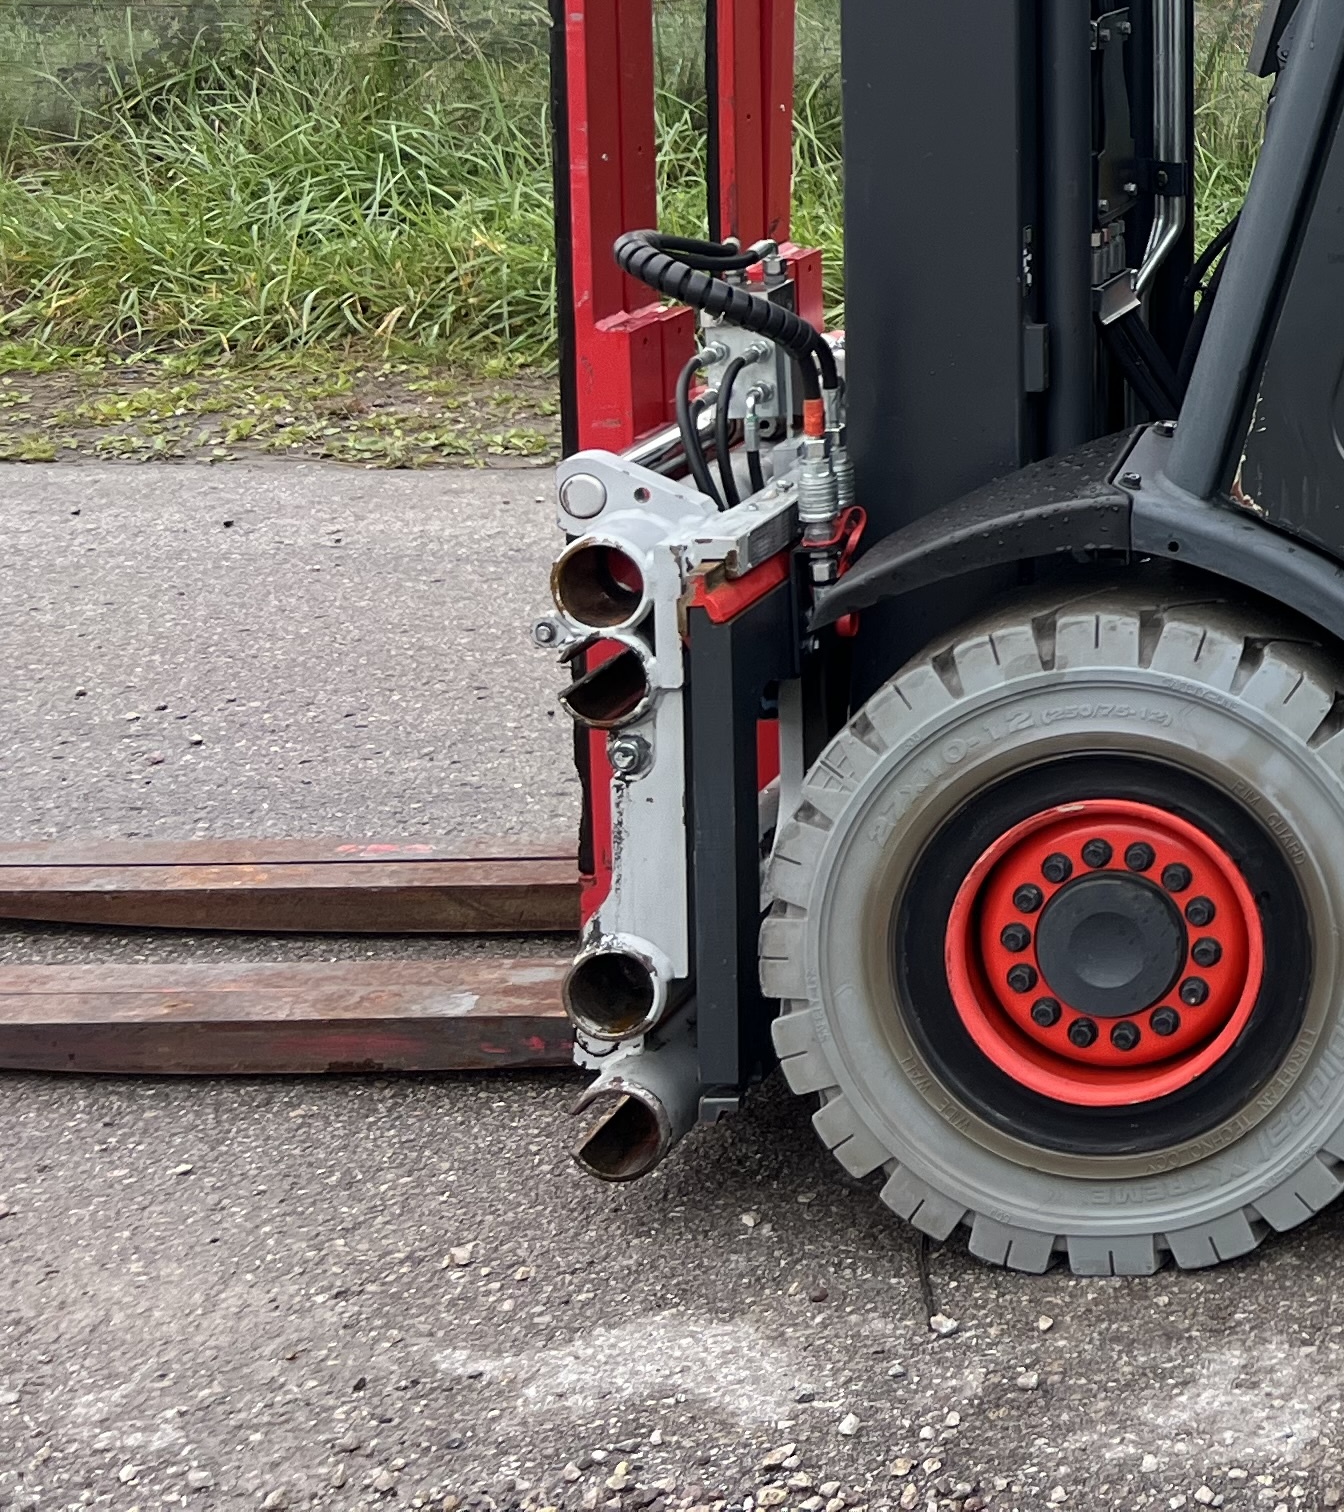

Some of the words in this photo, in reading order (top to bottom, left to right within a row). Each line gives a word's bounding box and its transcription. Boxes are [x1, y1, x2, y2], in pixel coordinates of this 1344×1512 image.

[1230, 777, 1263, 807] RIM
[1263, 809, 1309, 868] GUARD
[895, 1049, 937, 1095] WALL
[1253, 1025, 1321, 1112] EUROPEAN
[932, 1095, 975, 1132] WIDE
[1142, 1111, 1254, 1173] TECHNOLOGY
